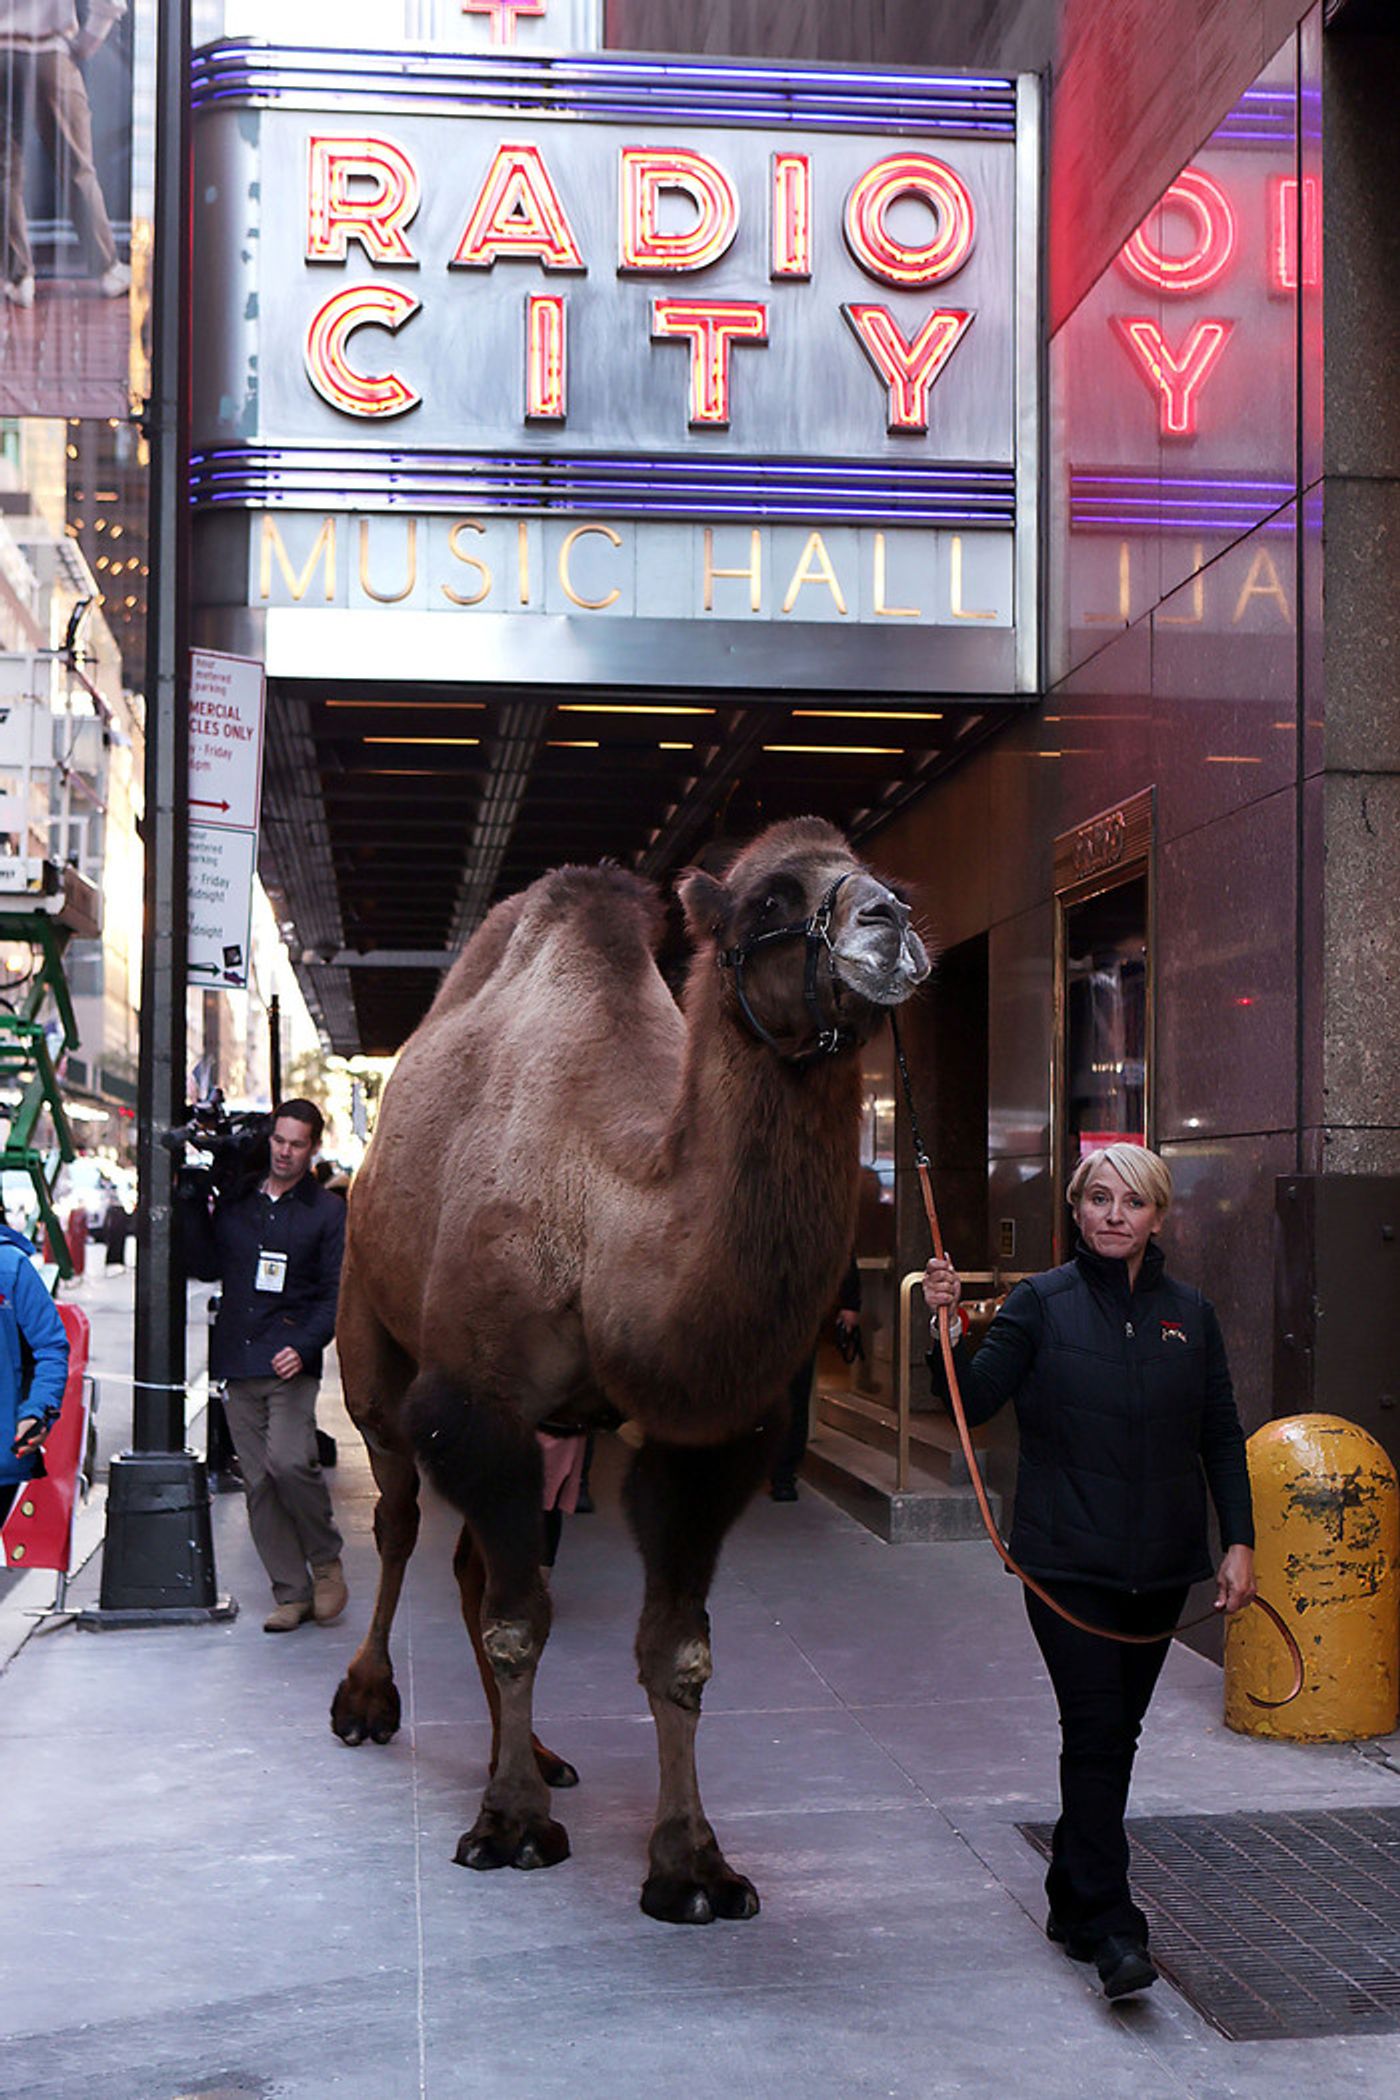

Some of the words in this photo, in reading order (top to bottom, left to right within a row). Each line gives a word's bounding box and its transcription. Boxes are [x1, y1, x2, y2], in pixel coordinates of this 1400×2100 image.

[304, 130, 976, 288] RADIO
[303, 279, 976, 436] CITY
[259, 514, 622, 611] MUSIC
[703, 523, 998, 622] HALL
[203, 743, 233, 761] Friday
[223, 724, 255, 742] ONLY
[201, 873, 230, 889] Friday
